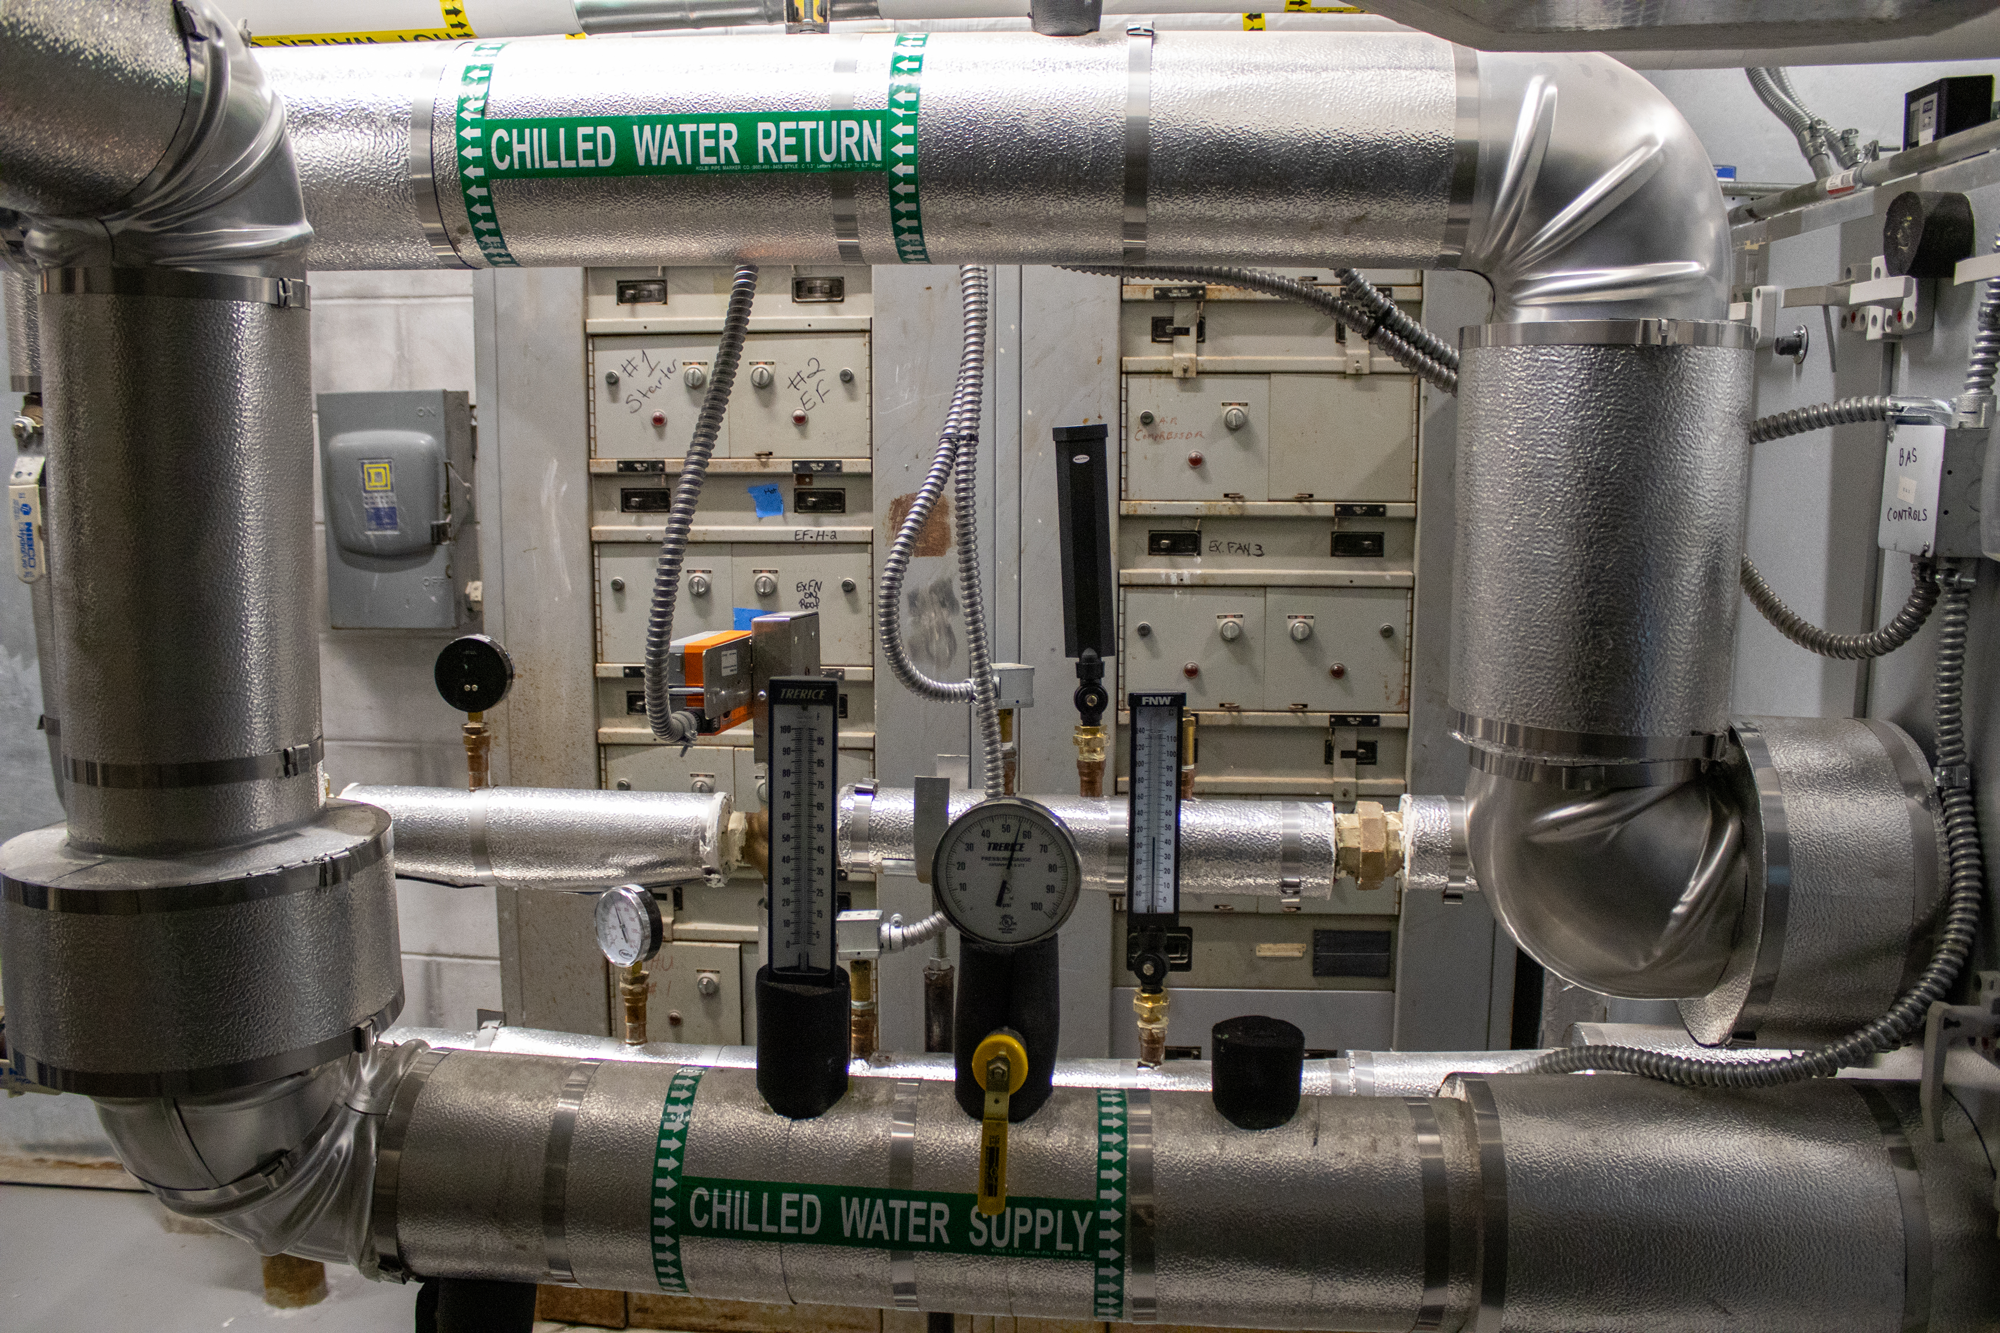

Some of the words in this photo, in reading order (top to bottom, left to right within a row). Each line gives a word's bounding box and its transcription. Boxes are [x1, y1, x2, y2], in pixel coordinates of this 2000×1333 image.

[491, 125, 616, 171] CHILLED
[633, 122, 739, 167] WATER
[757, 119, 882, 164] RETURN
[625, 358, 677, 414] Starter
[800, 379, 831, 411] EF
[416, 406, 437, 417] ON
[1899, 447, 1917, 467] BAS
[1887, 507, 1928, 522] CONTROLS
[780, 688, 827, 700] TRERICE
[1141, 696, 1172, 706] FNW
[780, 725, 791, 734] 100
[817, 737, 824, 746] 95
[1166, 735, 1177, 743] 110
[782, 747, 791, 755] 90
[1166, 750, 1177, 758] 100
[817, 759, 824, 768] 85
[782, 769, 791, 777] 80
[817, 780, 824, 789] 75
[782, 791, 791, 799] 70
[1165, 794, 1172, 802] 70
[817, 802, 824, 811] 65
[782, 812, 791, 821] 60
[1164, 809, 1172, 817] 60
[817, 824, 824, 833] 55
[1001, 824, 1011, 833] 50
[981, 829, 991, 838] 40
[1022, 830, 1032, 840] 60
[782, 834, 791, 843] 50
[1164, 838, 1171, 846] 40
[817, 846, 824, 854] 45
[965, 842, 974, 852] 30
[1040, 844, 1048, 853] 70
[781, 855, 790, 864] 40
[956, 861, 966, 871] 20
[1048, 863, 1057, 873] 80
[816, 867, 824, 876] 35
[1163, 867, 1171, 875] 20
[782, 877, 790, 885] 30
[959, 882, 967, 892] 10
[1046, 884, 1055, 894] 90
[816, 889, 824, 897] 25
[782, 898, 790, 907] 20
[1030, 902, 1043, 911] 100
[816, 910, 823, 918] 15
[783, 919, 790, 928] 10
[689, 1186, 822, 1235] CHILLED
[841, 1196, 951, 1244] WATER
[968, 1203, 1093, 1251] SUPPLY
